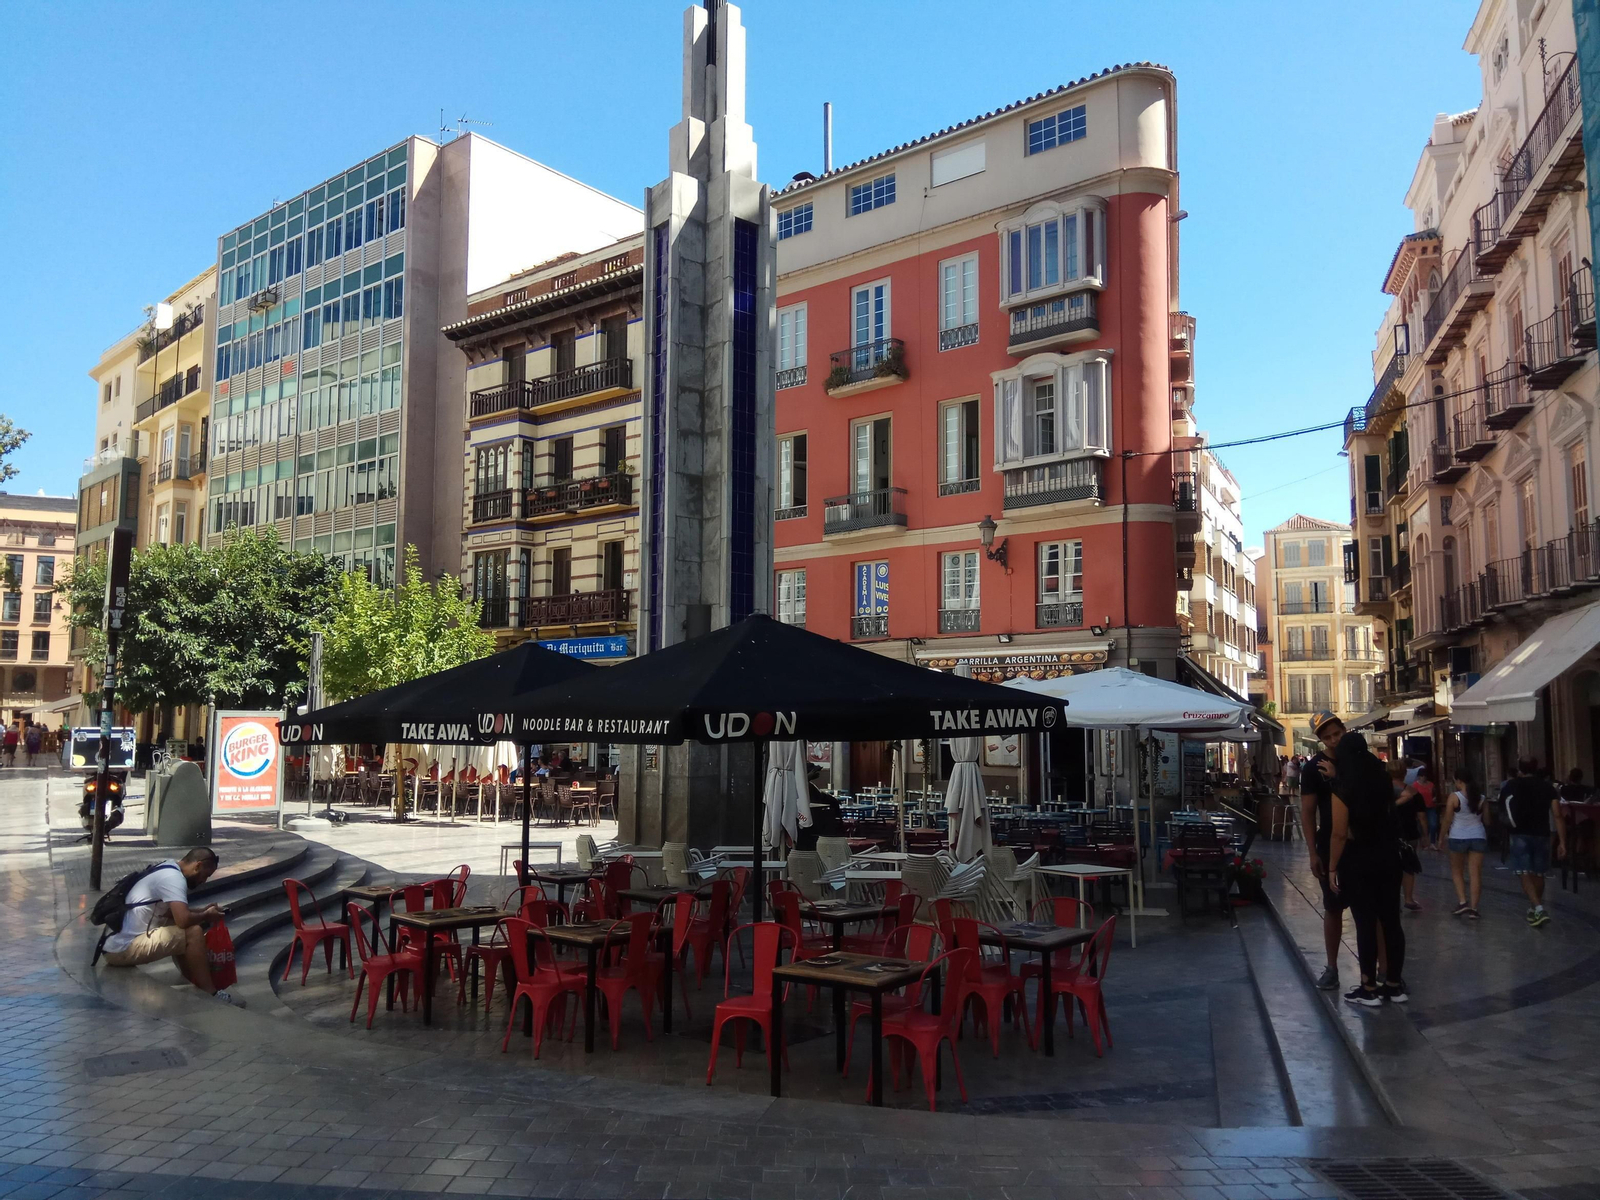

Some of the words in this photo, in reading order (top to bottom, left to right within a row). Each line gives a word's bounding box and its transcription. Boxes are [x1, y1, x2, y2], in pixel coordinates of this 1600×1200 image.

[876, 581, 889, 591] LUIS
[559, 642, 605, 655] Mariquita
[610, 643, 623, 651] Bar
[1004, 655, 1058, 664] ARGENTINA
[477, 713, 514, 734] UDON
[522, 717, 561, 731] NOODLE
[564, 718, 583, 732] BAR
[587, 719, 593, 732] &
[597, 719, 670, 735] RESTAURANT
[929, 709, 980, 730] TAKE
[984, 708, 1038, 729] AWAY
[1183, 711, 1230, 719] Cruzcampo
[280, 723, 323, 742] UDON
[401, 723, 434, 740] TAKE
[704, 711, 797, 739] UDON
[228, 733, 268, 753] BURGER
[229, 742, 269, 766] KING
